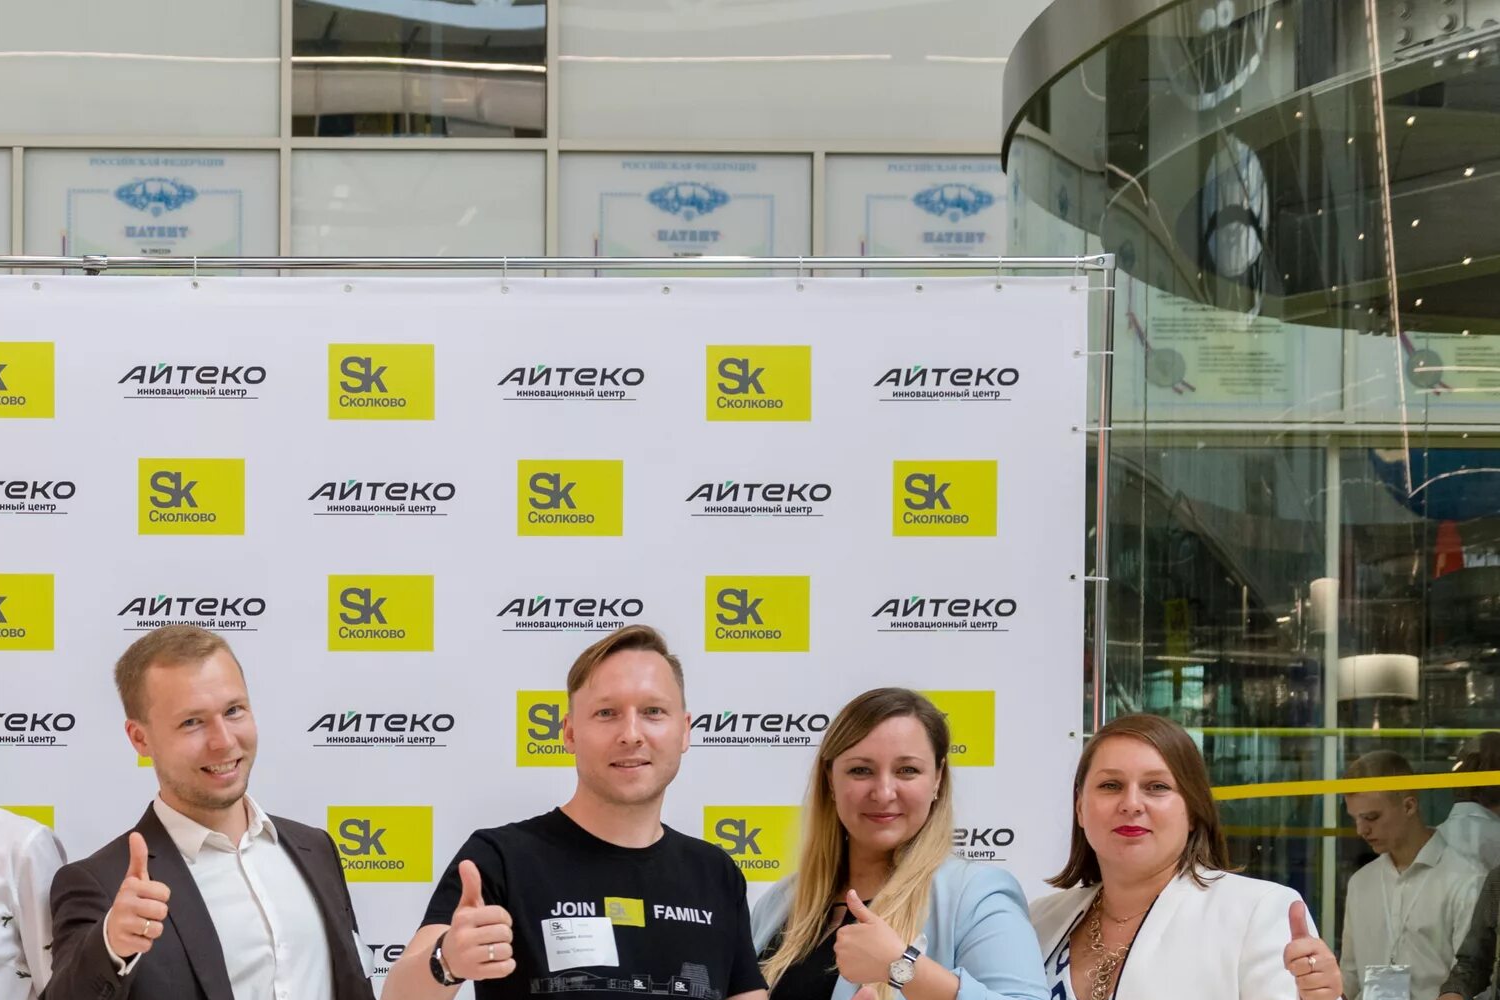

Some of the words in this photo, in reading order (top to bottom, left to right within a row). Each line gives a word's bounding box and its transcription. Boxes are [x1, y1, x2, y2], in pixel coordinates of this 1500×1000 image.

[125, 226, 189, 238] ПАТЕНТ
[657, 230, 720, 242] ПАТЕНТ
[922, 232, 986, 243] ПАТЕНТ
[340, 357, 388, 393] Sk
[718, 358, 765, 395] Sk
[137, 387, 216, 396] инновационный
[218, 388, 248, 397] центр
[517, 389, 595, 398] инновационный
[596, 390, 626, 399] центр
[893, 389, 970, 398] инновационный
[972, 390, 1001, 399] центр
[340, 395, 406, 407] Сколково
[717, 397, 783, 408] Сколково
[150, 471, 198, 508] Sk
[529, 473, 576, 509] Sk
[904, 473, 951, 510] Sk
[27, 503, 57, 512] центр
[327, 503, 406, 512] инновационный
[407, 504, 437, 513] центр
[705, 504, 783, 513] инновационный
[784, 505, 813, 514] центр
[149, 510, 216, 522] Сколково
[528, 511, 594, 523] Сколково
[903, 512, 969, 524] Сколково
[340, 588, 387, 625] Sk
[716, 588, 763, 625] Sk
[217, 620, 248, 629] центр
[516, 619, 594, 628] инновационный
[891, 620, 968, 629] инновационный
[969, 621, 999, 630] центр
[339, 627, 405, 638] Сколково
[716, 627, 781, 639] Сколково
[27, 735, 57, 745] центр
[327, 735, 405, 744] инновационный
[406, 736, 436, 745] центр
[703, 735, 780, 745] инновационный
[782, 736, 811, 745] центр
[338, 818, 387, 856] Sk
[715, 818, 762, 856] Sk
[967, 850, 996, 860] центр
[340, 857, 405, 870] Сколково
[550, 901, 596, 917] JOIN
[653, 904, 713, 925] FAMILY
